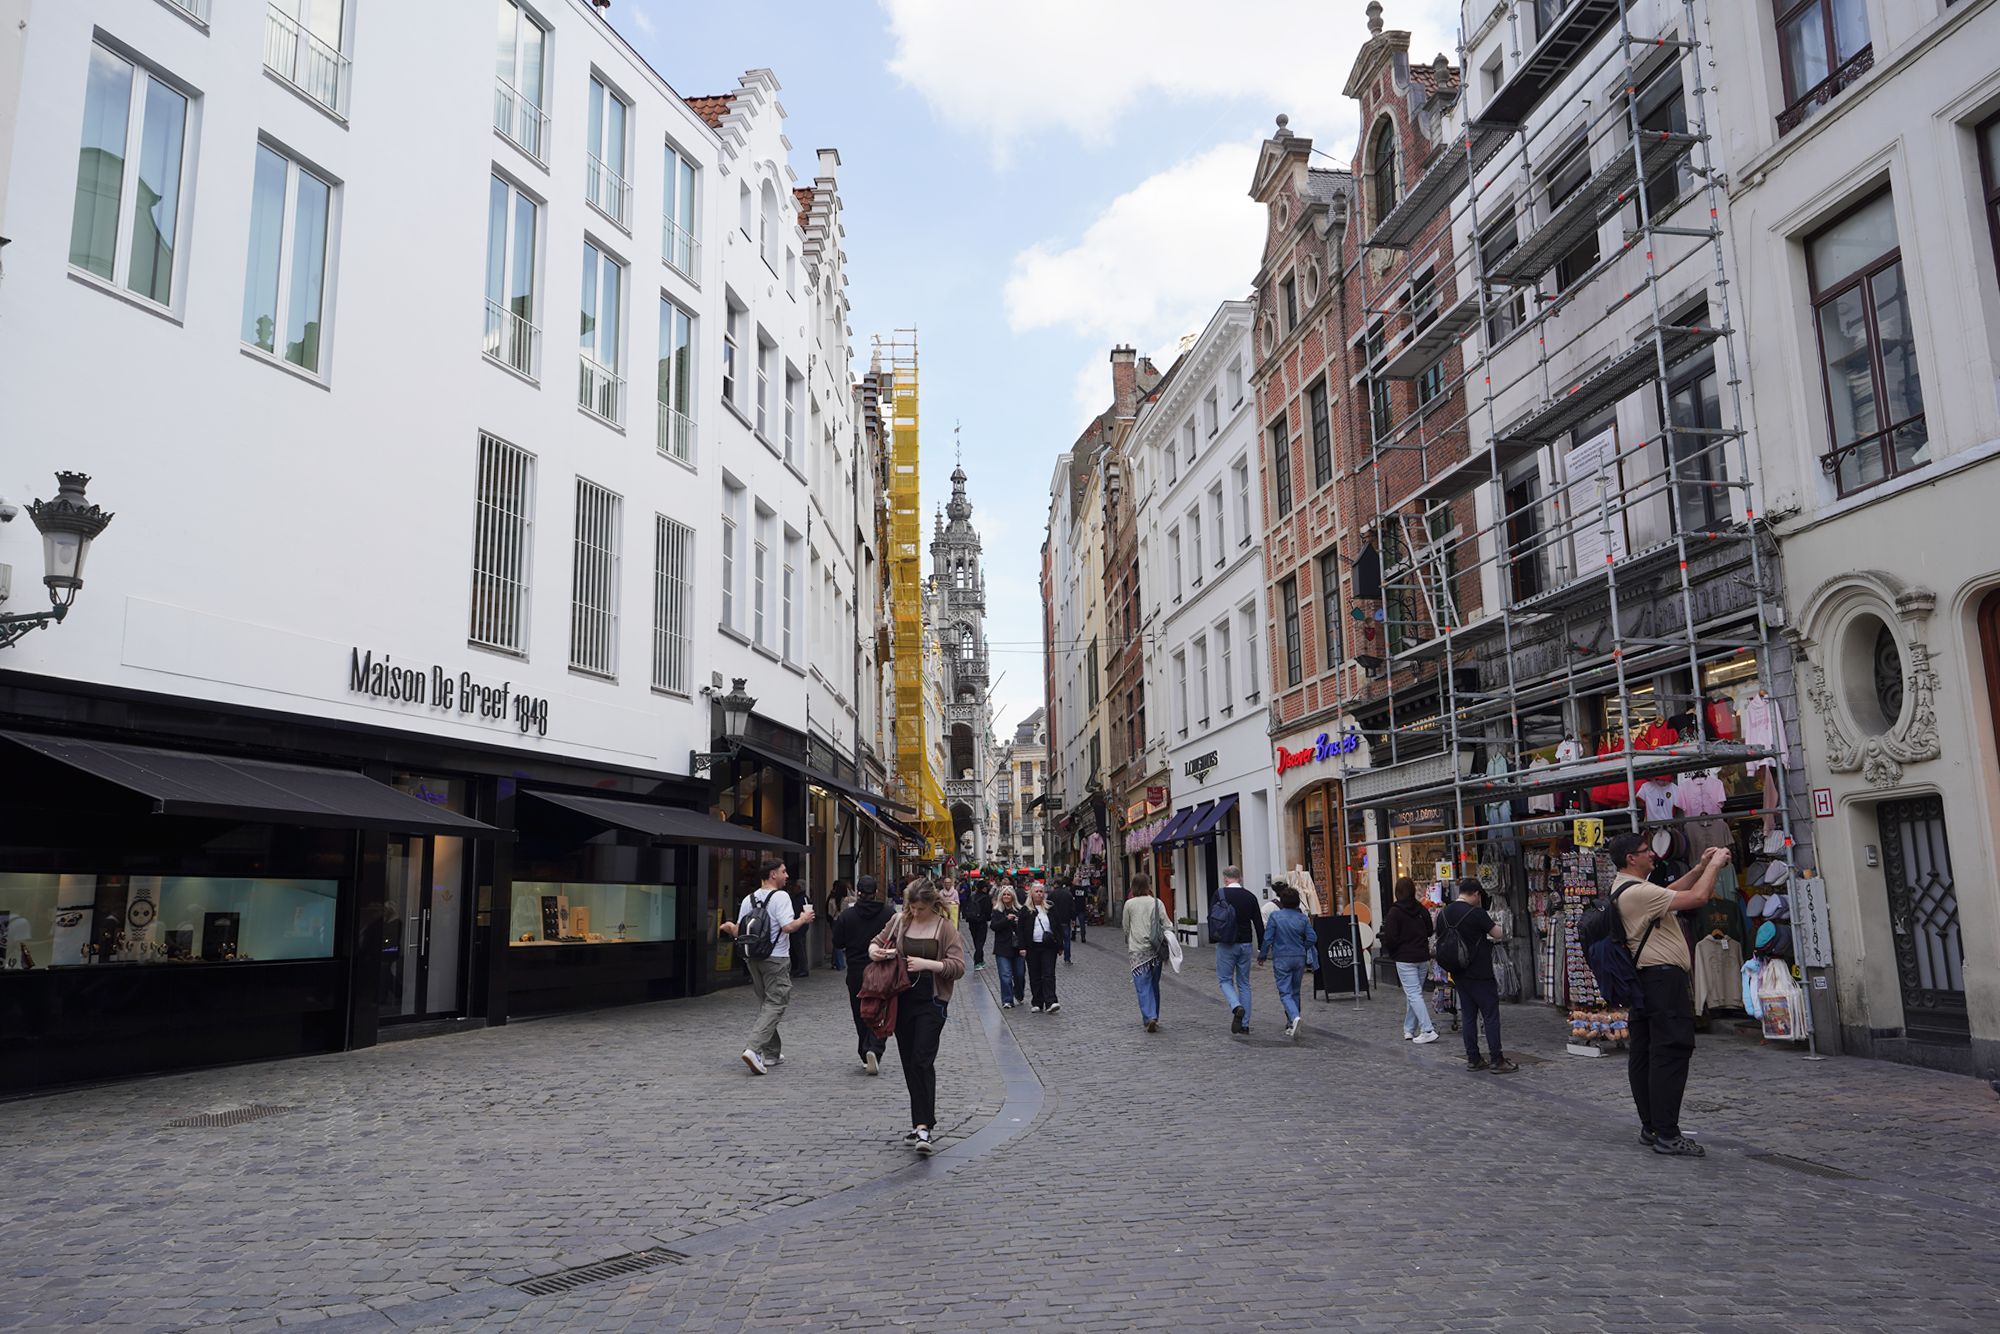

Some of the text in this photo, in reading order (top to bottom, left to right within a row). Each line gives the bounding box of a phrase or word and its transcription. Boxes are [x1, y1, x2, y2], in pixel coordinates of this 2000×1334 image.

[350, 646, 548, 736] Maison De Greef 1848
[1276, 725, 1359, 775] Discover Brusels
[1817, 793, 1829, 812] H
[1328, 948, 1354, 958] DANDO
